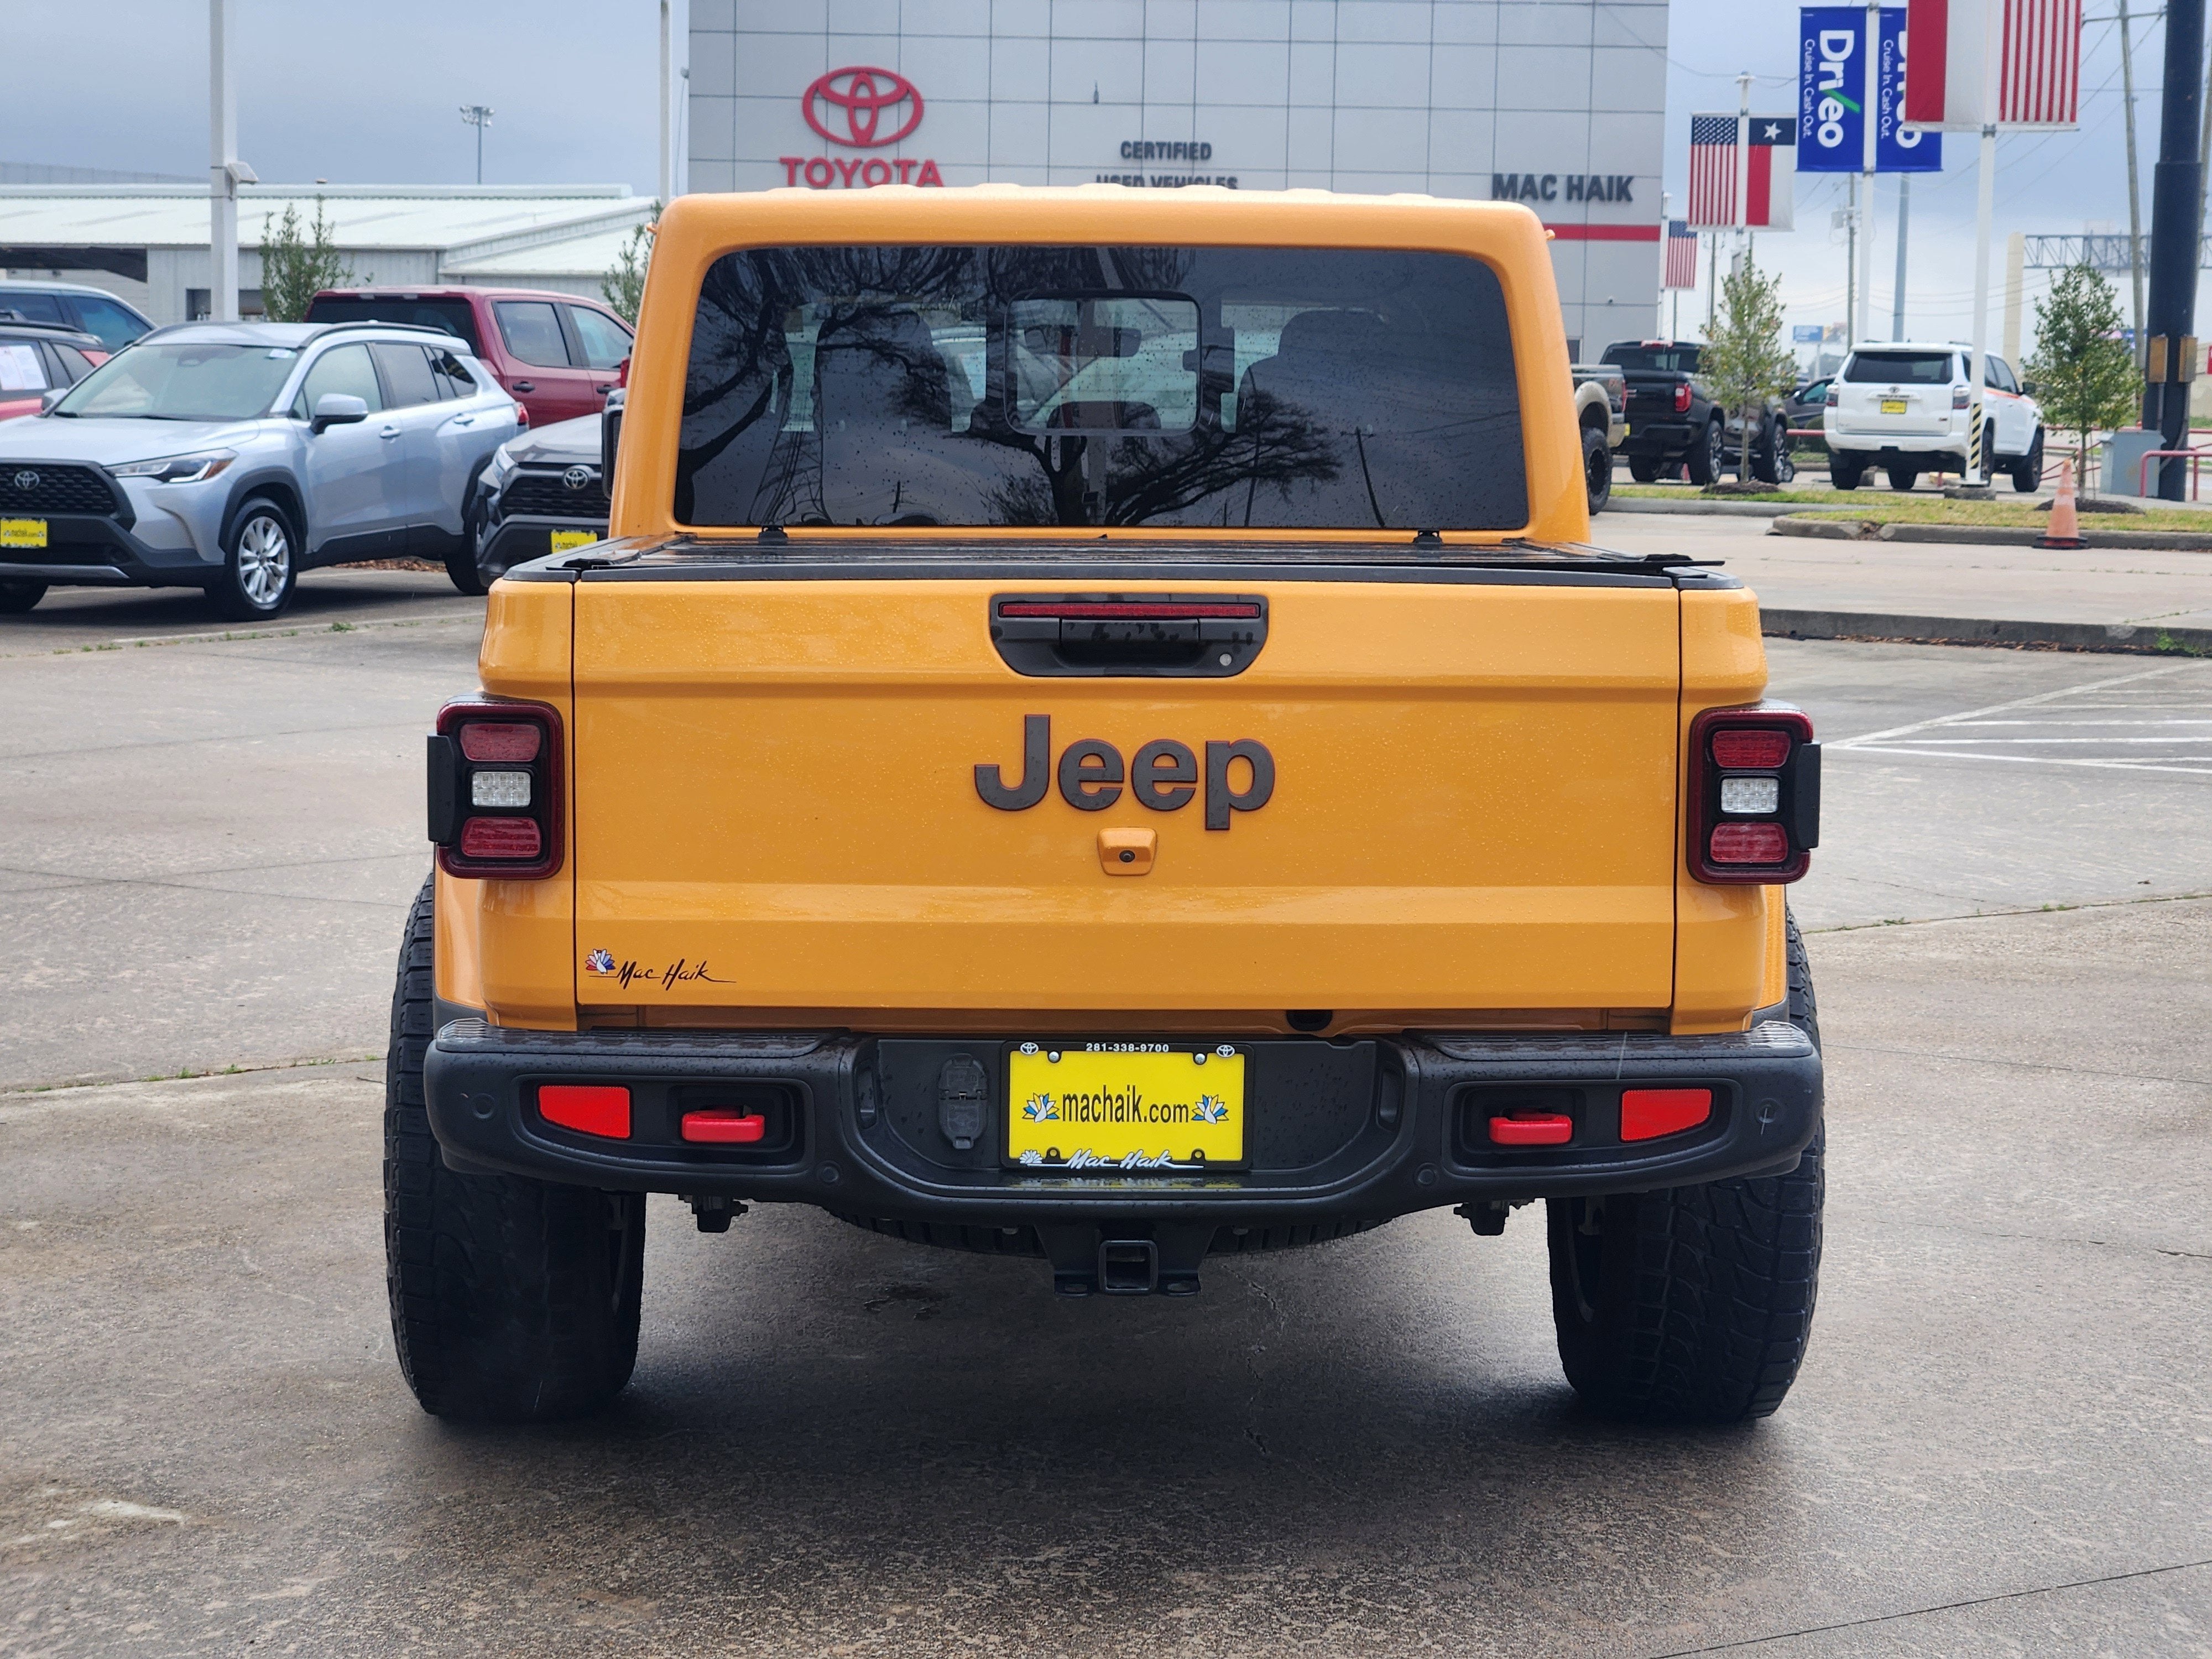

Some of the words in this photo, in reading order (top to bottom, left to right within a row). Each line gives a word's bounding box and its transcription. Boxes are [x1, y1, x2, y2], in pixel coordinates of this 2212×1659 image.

[1804, 39, 1815, 72] Cruise
[1882, 39, 1894, 72] Cruise
[1804, 87, 1815, 113] Cash
[1882, 88, 1892, 114] Cash
[1120, 140, 1212, 160] CERTIFIED
[780, 156, 943, 187] TOYOTA
[1492, 173, 1558, 201] MAC
[1566, 174, 1634, 202] HAIK
[974, 714, 1276, 831] Jeep
[615, 961, 661, 990] Mac
[661, 958, 737, 990] Haik
[1086, 1042, 1170, 1052] 281-338-9700
[1062, 1084, 1189, 1123] machaik.com
[1065, 1148, 1119, 1170] Mac
[1119, 1149, 1204, 1170] Haik
